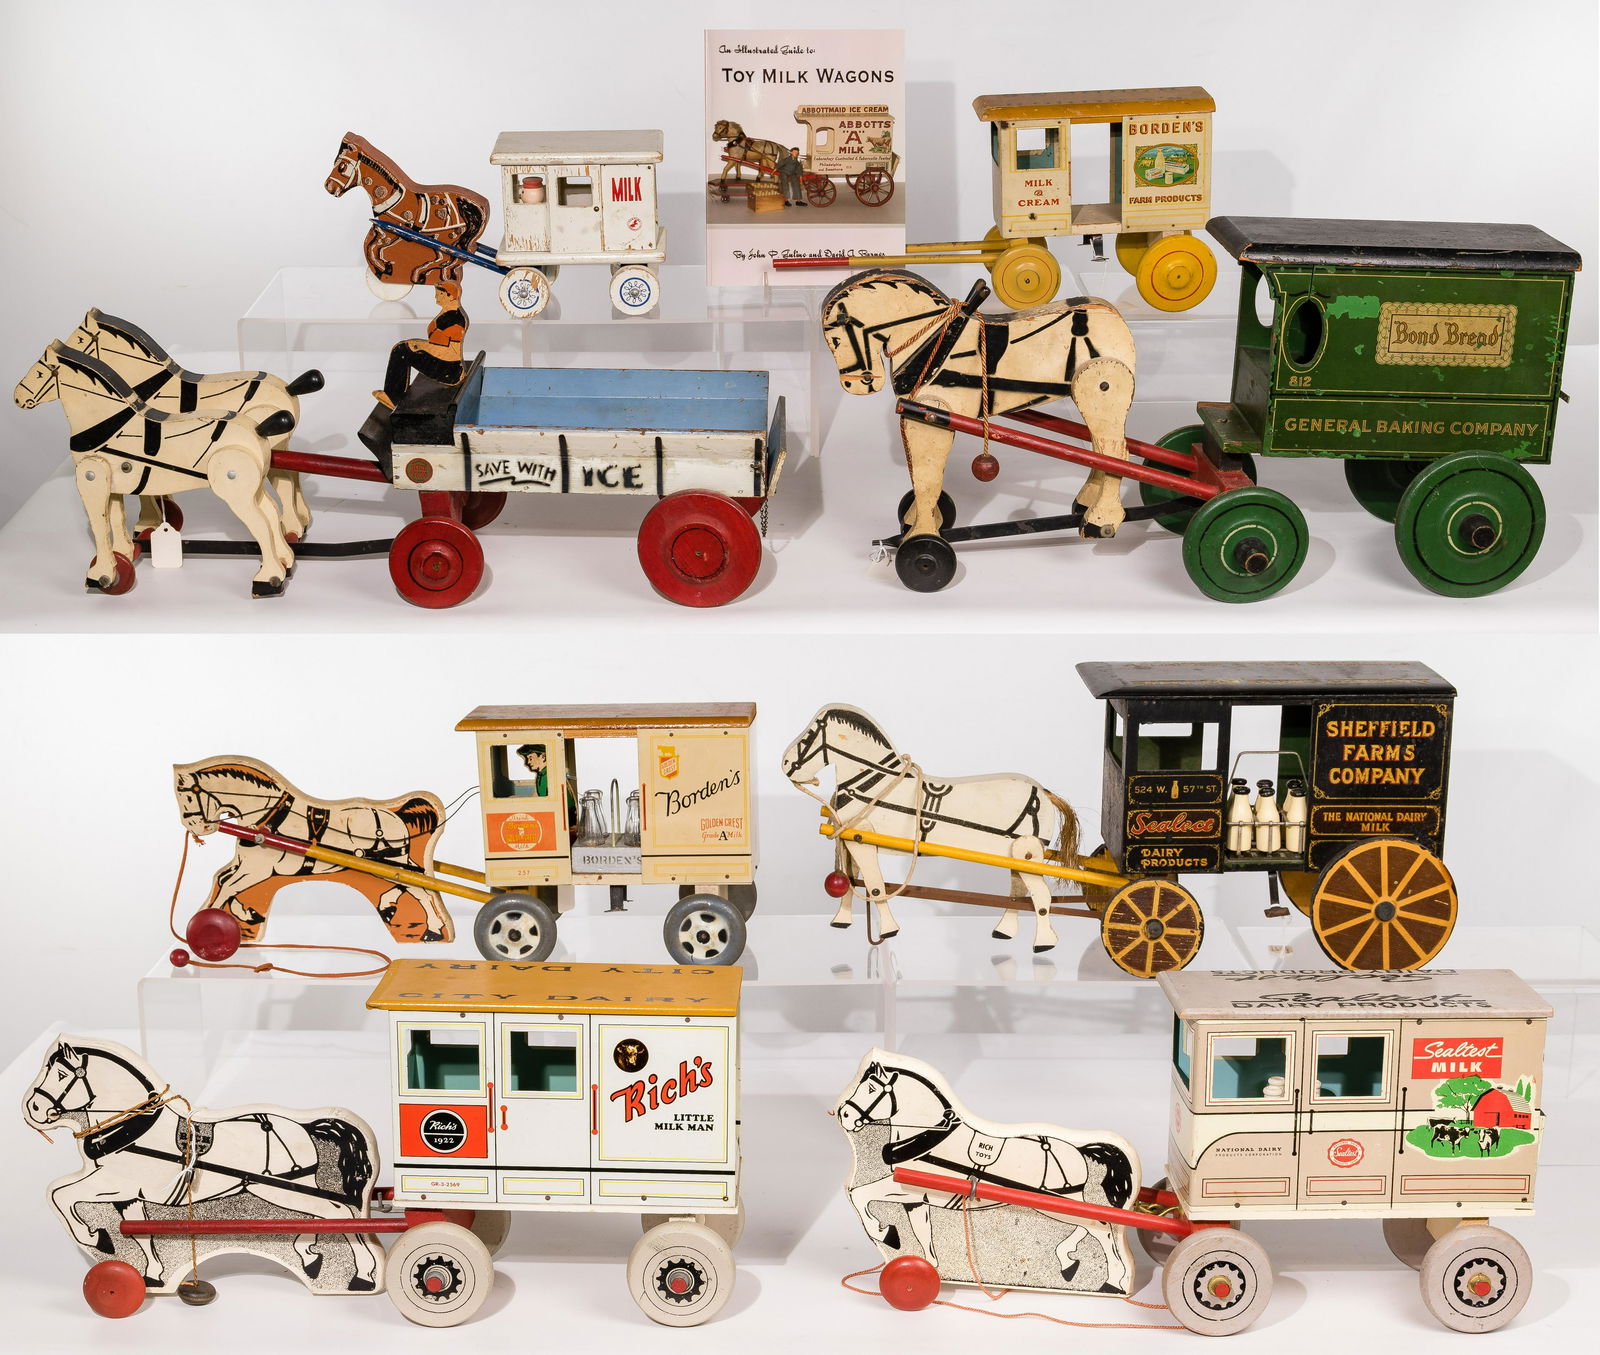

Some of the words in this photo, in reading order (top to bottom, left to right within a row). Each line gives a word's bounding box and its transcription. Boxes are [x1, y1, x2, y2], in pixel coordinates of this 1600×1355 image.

[719, 45, 732, 54] An
[734, 45, 778, 54] Illustrated
[780, 45, 804, 55] Guide
[722, 68, 755, 83] TOY
[762, 68, 809, 84] MILK
[816, 68, 894, 83] WAGONS
[802, 106, 847, 114] ABBOTTMAID
[839, 120, 892, 129] ABBOTTS
[1129, 120, 1204, 136] BORDEN'S
[838, 146, 864, 154] MILK
[1024, 179, 1053, 188] MILK
[611, 177, 643, 202] MILK
[1018, 198, 1060, 207] CREAM
[1129, 196, 1153, 205] FARM
[1155, 194, 1203, 203] PRODUCTS
[733, 250, 745, 261] By
[1391, 320, 1440, 346] Bond
[1443, 322, 1500, 347] Bread
[1289, 375, 1312, 387] 812
[1284, 417, 1371, 433] GENERAL
[1376, 420, 1445, 434] BAKING
[1450, 421, 1539, 437] COMPANY
[475, 460, 510, 478] SAVE
[517, 461, 556, 481] WITH
[582, 463, 643, 489] ICE
[1326, 720, 1436, 738] SHEFFIELD
[1342, 744, 1416, 761] FARMS
[1328, 767, 1426, 784] COMPANY
[655, 769, 740, 817] Borden's
[1134, 785, 1153, 794] 524
[1156, 785, 1168, 793] W.
[1322, 812, 1342, 822] THE
[1346, 812, 1394, 822] NATIONAL
[1396, 812, 1428, 822] DAIRY
[701, 818, 724, 831] GOLDEN
[724, 817, 743, 829] CREST
[1361, 823, 1391, 832] MILK
[1141, 848, 1184, 857] DAIRY
[583, 855, 641, 865] BORDEN'S
[1141, 858, 1208, 869] PRODUCTS
[416, 963, 572, 972] DAIRY
[601, 967, 715, 975] CITY
[398, 992, 517, 1000] CITY
[546, 995, 709, 1003] DAIRY
[1415, 1041, 1502, 1059] Sealtest
[1431, 1062, 1482, 1073] MILK
[610, 1056, 713, 1123] Rich's
[674, 1114, 714, 1122] LITTLE
[429, 1120, 457, 1131] Rich's
[655, 1123, 684, 1131] MILK
[687, 1124, 714, 1132] MAN
[434, 1137, 455, 1145] 1922
[979, 1142, 994, 1151] RICH
[976, 1151, 991, 1159] TOYS
